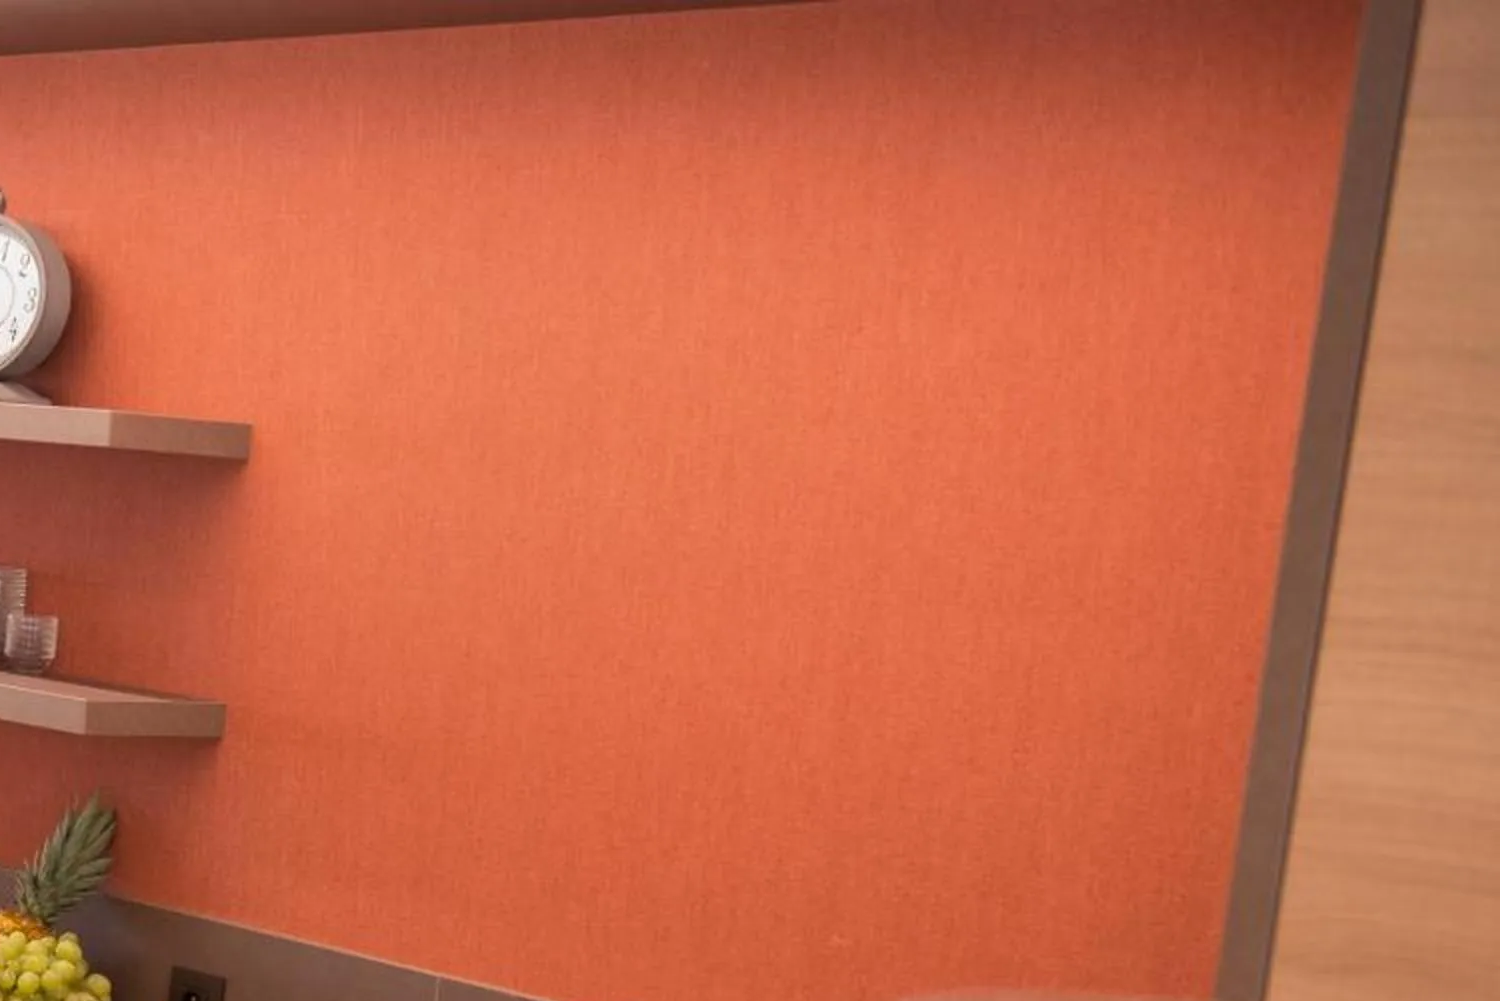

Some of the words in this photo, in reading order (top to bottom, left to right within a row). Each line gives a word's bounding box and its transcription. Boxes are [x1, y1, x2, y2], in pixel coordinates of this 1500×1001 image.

[2, 239, 10, 262] 1
[19, 253, 31, 278] 2
[23, 286, 37, 313] 3
[9, 316, 18, 342] 4
